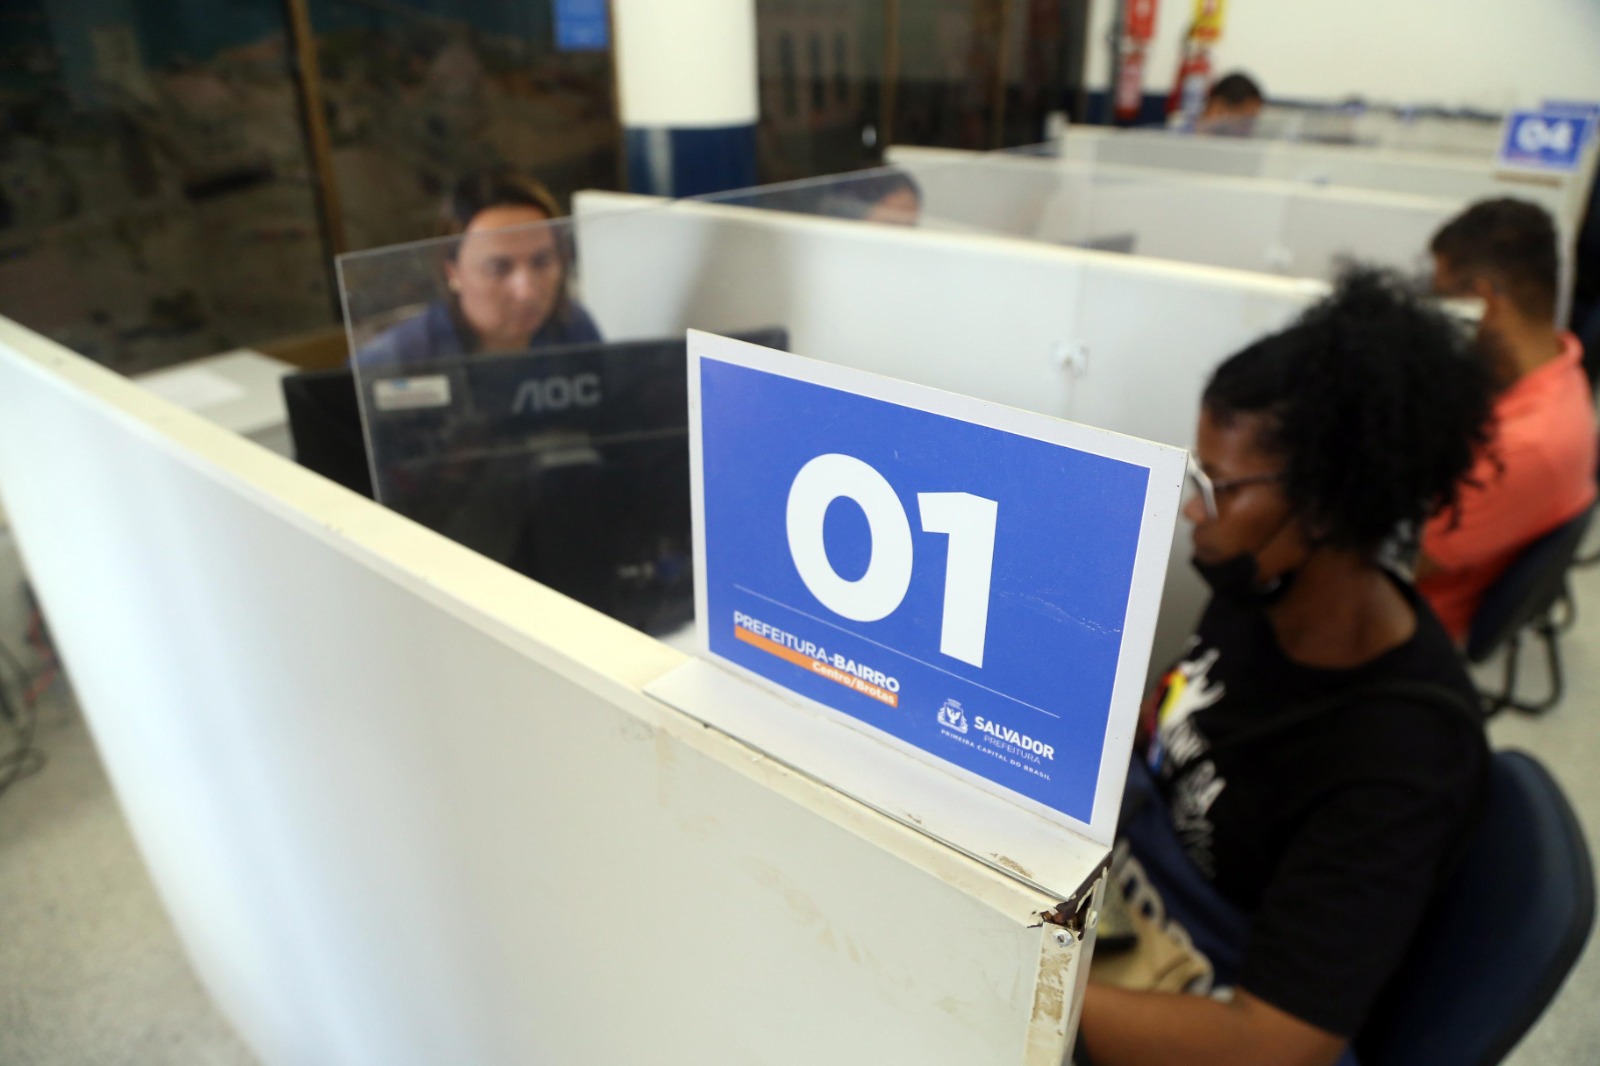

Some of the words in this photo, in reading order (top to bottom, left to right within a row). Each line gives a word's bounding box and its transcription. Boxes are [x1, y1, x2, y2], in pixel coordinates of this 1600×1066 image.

[1518, 119, 1571, 152] 04
[786, 453, 998, 668] 01
[734, 611, 900, 692] PREFEITURA-BAIRRO
[812, 661, 895, 704] Centro/Brotas
[941, 729, 975, 748] PRIMEIRA
[977, 745, 1008, 762] CAPITAL
[1023, 765, 1051, 781] BRASIL
[974, 716, 1055, 760] SALVADOR
[984, 735, 1041, 765] PREFEITURA
